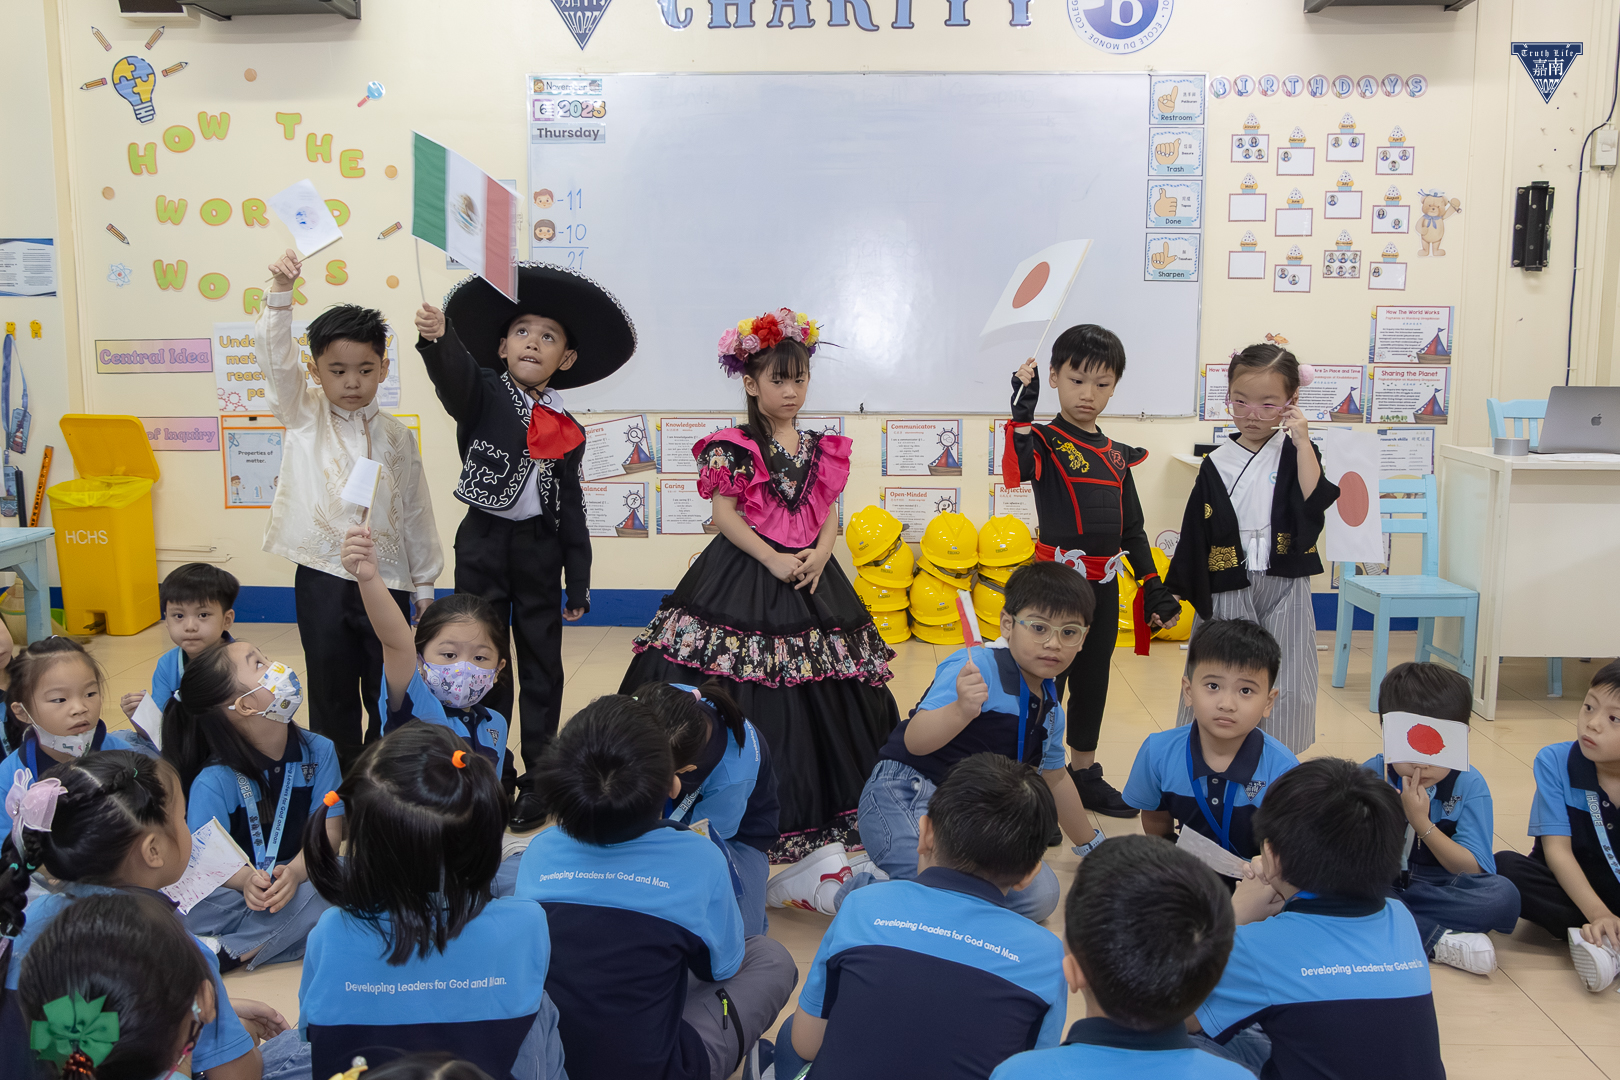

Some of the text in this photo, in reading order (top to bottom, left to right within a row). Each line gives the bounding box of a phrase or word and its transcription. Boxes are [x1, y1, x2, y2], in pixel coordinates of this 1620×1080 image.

[563, 11, 601, 33] HOPE
[1087, 33, 1120, 50] MONDE
[1123, 42, 1137, 50] DU
[1521, 49, 1574, 57] Truth Life
[1532, 57, 1565, 76] 嘉南
[1215, 77, 1424, 96] BIRTHDAYS
[128, 111, 230, 175] HOW
[537, 127, 600, 141] Thursday
[276, 111, 365, 178] THE
[155, 194, 351, 227] WORD
[99, 347, 210, 365] Central Idea
[1381, 370, 1404, 378] Sharing
[164, 427, 216, 443] Inquiry
[999, 486, 1032, 495] Reflective
[65, 530, 109, 545] HCHS
[1586, 794, 1604, 827] HOPE
[539, 870, 670, 889] Developing Leaders for God and Man.
[873, 918, 1021, 963] Developing Leaders for God and Man.
[1301, 964, 1352, 977] Developing
[1352, 963, 1384, 973] Leaders
[1384, 962, 1394, 972] for
[1394, 961, 1409, 971] God
[345, 981, 395, 995] Developing
[397, 980, 434, 992] Leaders
[434, 979, 447, 990] for
[449, 978, 469, 989] God
[471, 977, 488, 988] and
